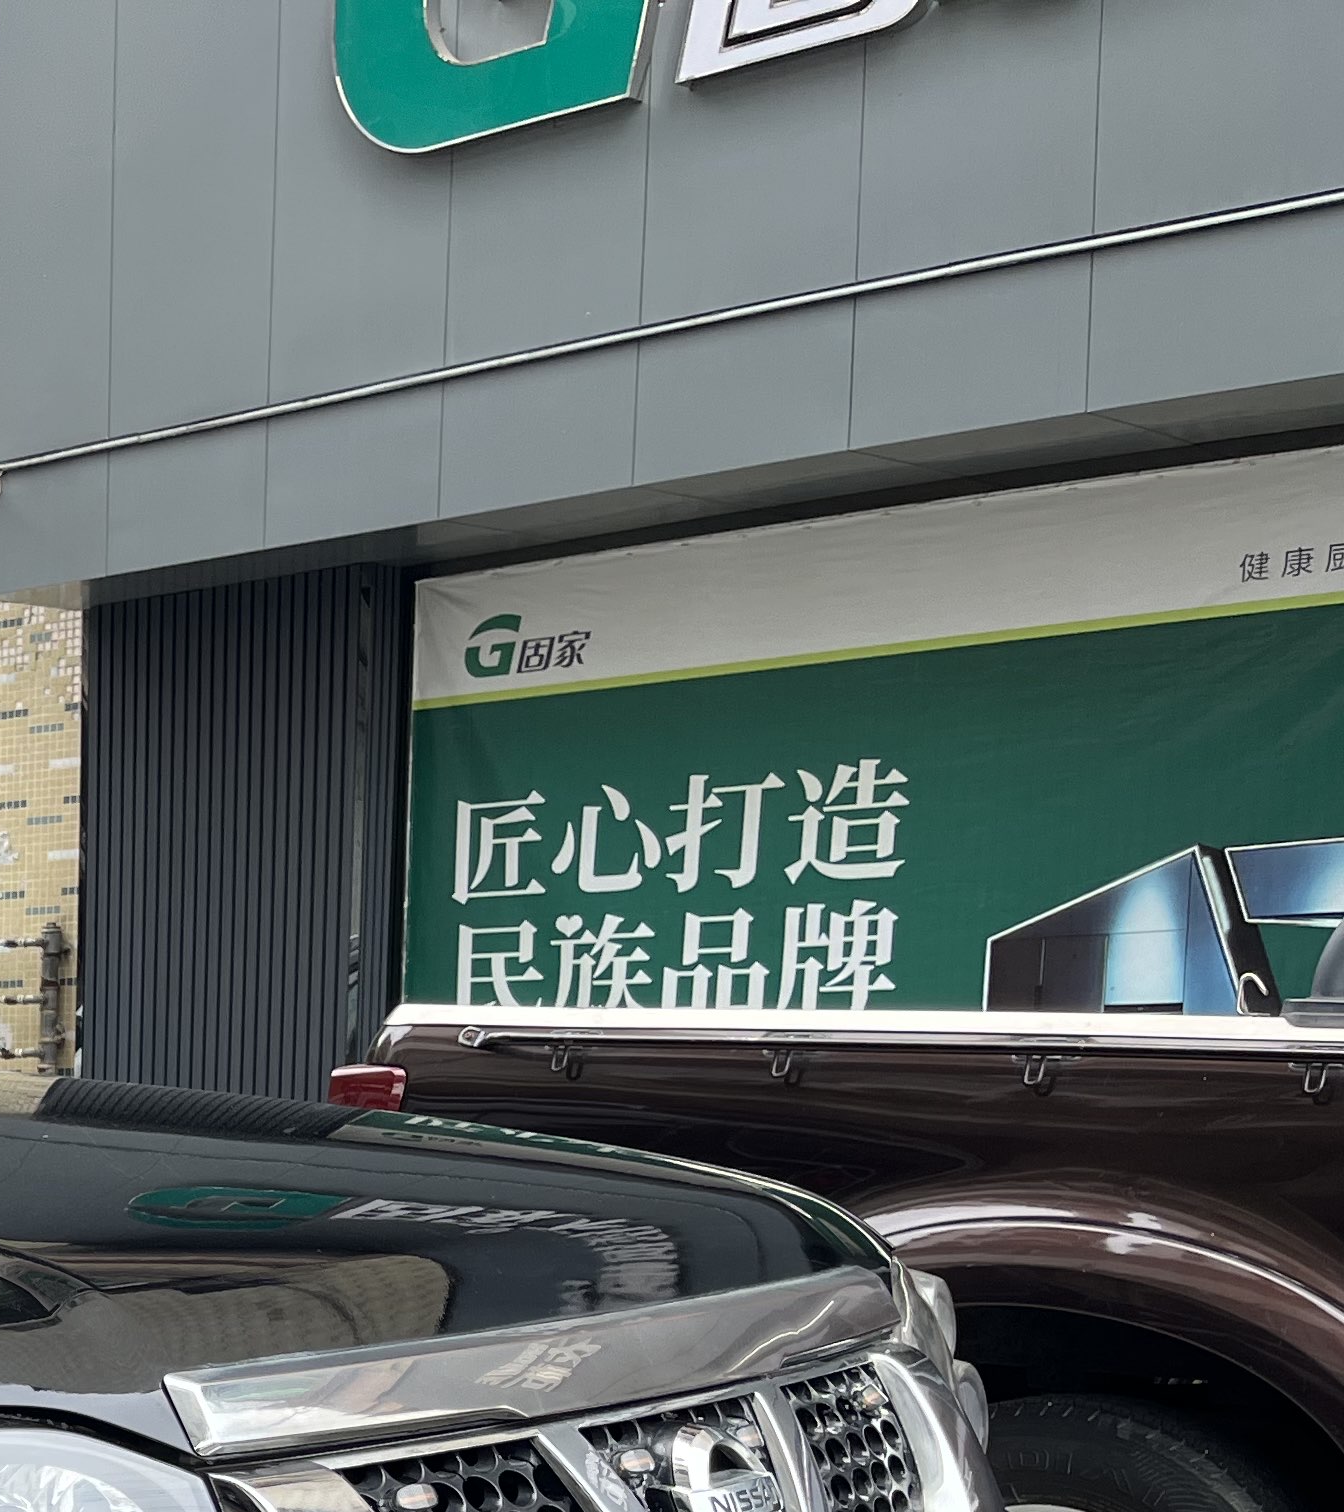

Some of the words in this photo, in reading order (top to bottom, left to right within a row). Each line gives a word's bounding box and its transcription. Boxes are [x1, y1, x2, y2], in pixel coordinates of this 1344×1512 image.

[516, 630, 592, 674] 固家
[452, 758, 910, 905] 匠心打造
[456, 899, 900, 1010] 民族品牌
